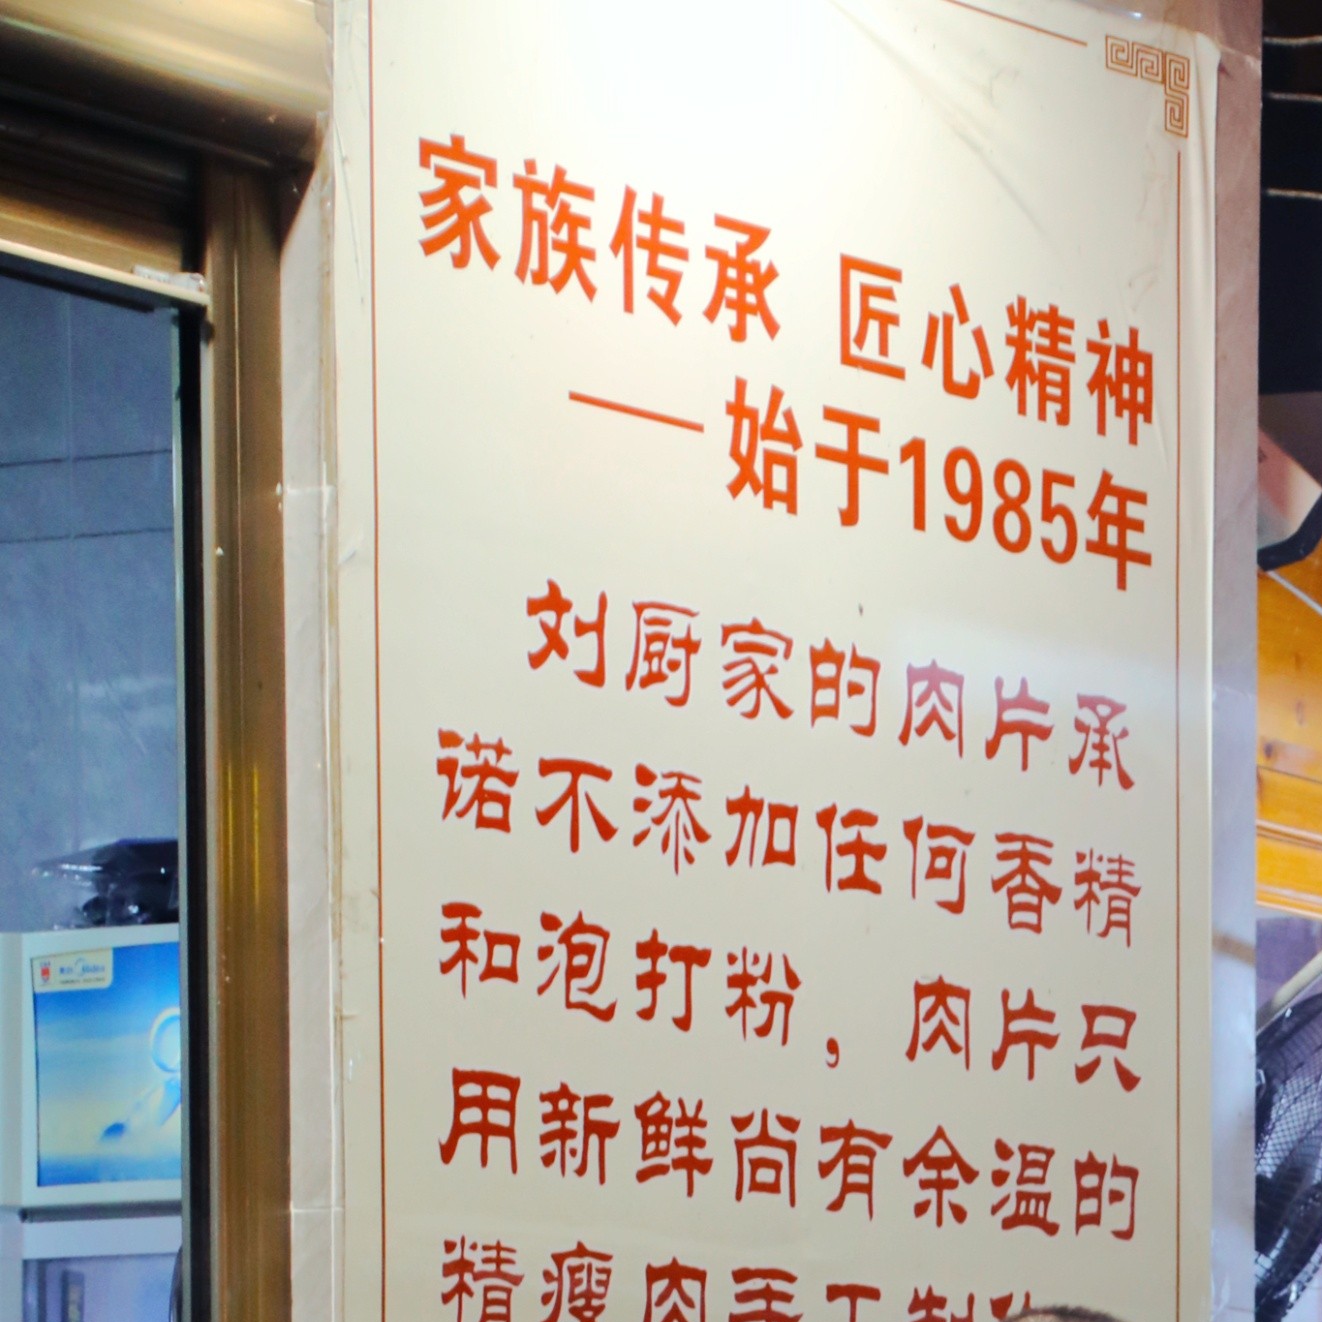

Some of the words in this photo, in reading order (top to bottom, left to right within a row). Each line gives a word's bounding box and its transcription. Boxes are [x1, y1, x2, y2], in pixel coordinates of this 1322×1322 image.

[417, 133, 781, 343] 家族传承
[838, 253, 1155, 447] 匠心精神
[525, 578, 1135, 791] 刘厨家的肉片承
[435, 728, 1143, 948] 诺不添加任何香精
[438, 1067, 1140, 1241] 用新鲜尚有余温的
